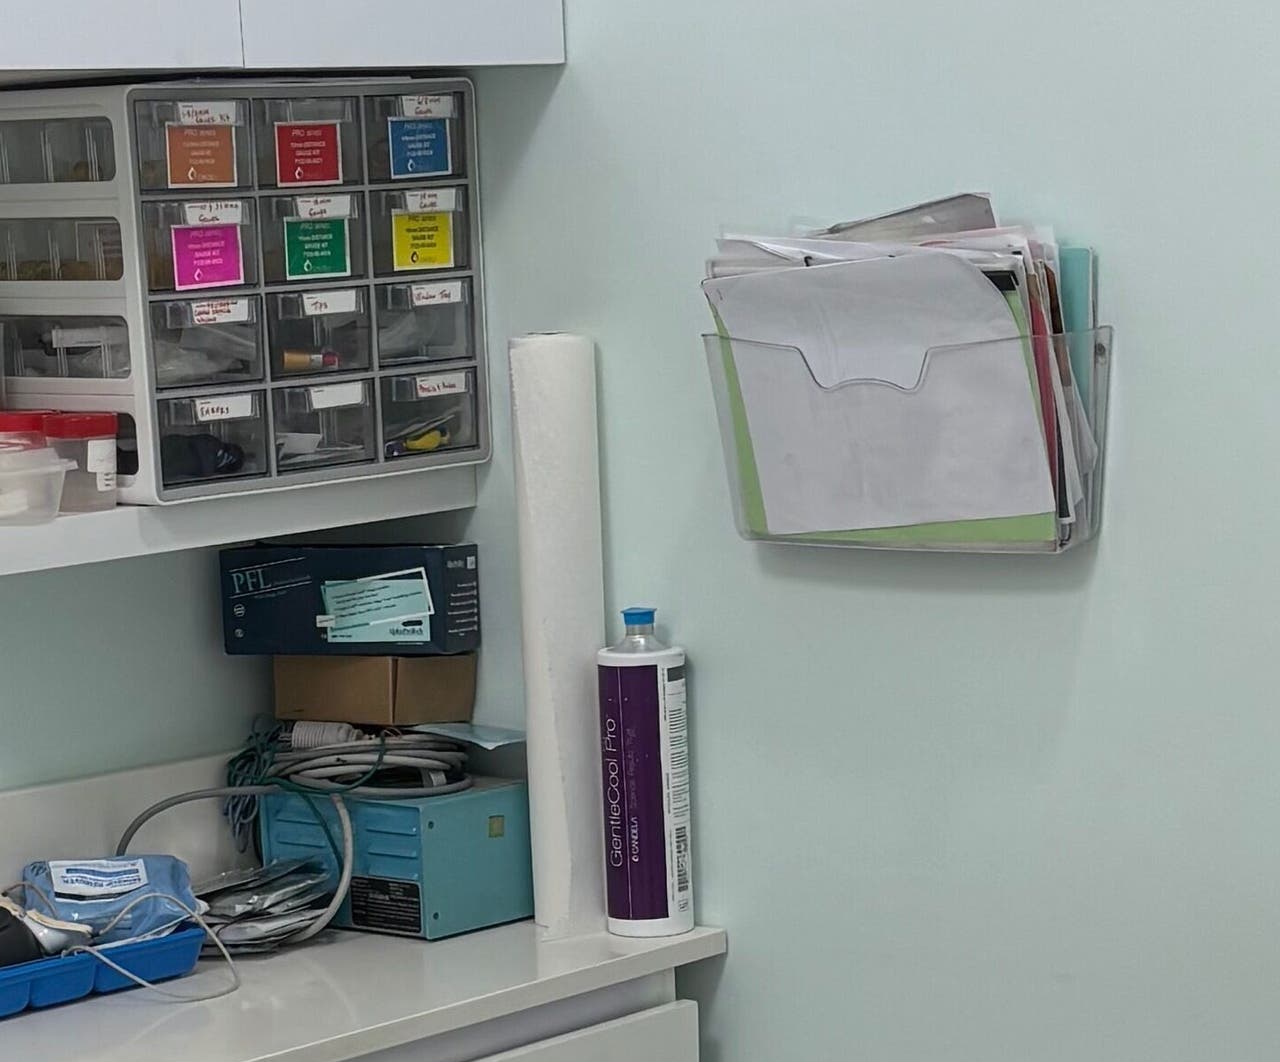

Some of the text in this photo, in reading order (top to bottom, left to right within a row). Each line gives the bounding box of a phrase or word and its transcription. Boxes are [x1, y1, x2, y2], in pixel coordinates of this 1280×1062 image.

[232, 568, 272, 594] PFL
[605, 718, 623, 867] GentleCool Pro
